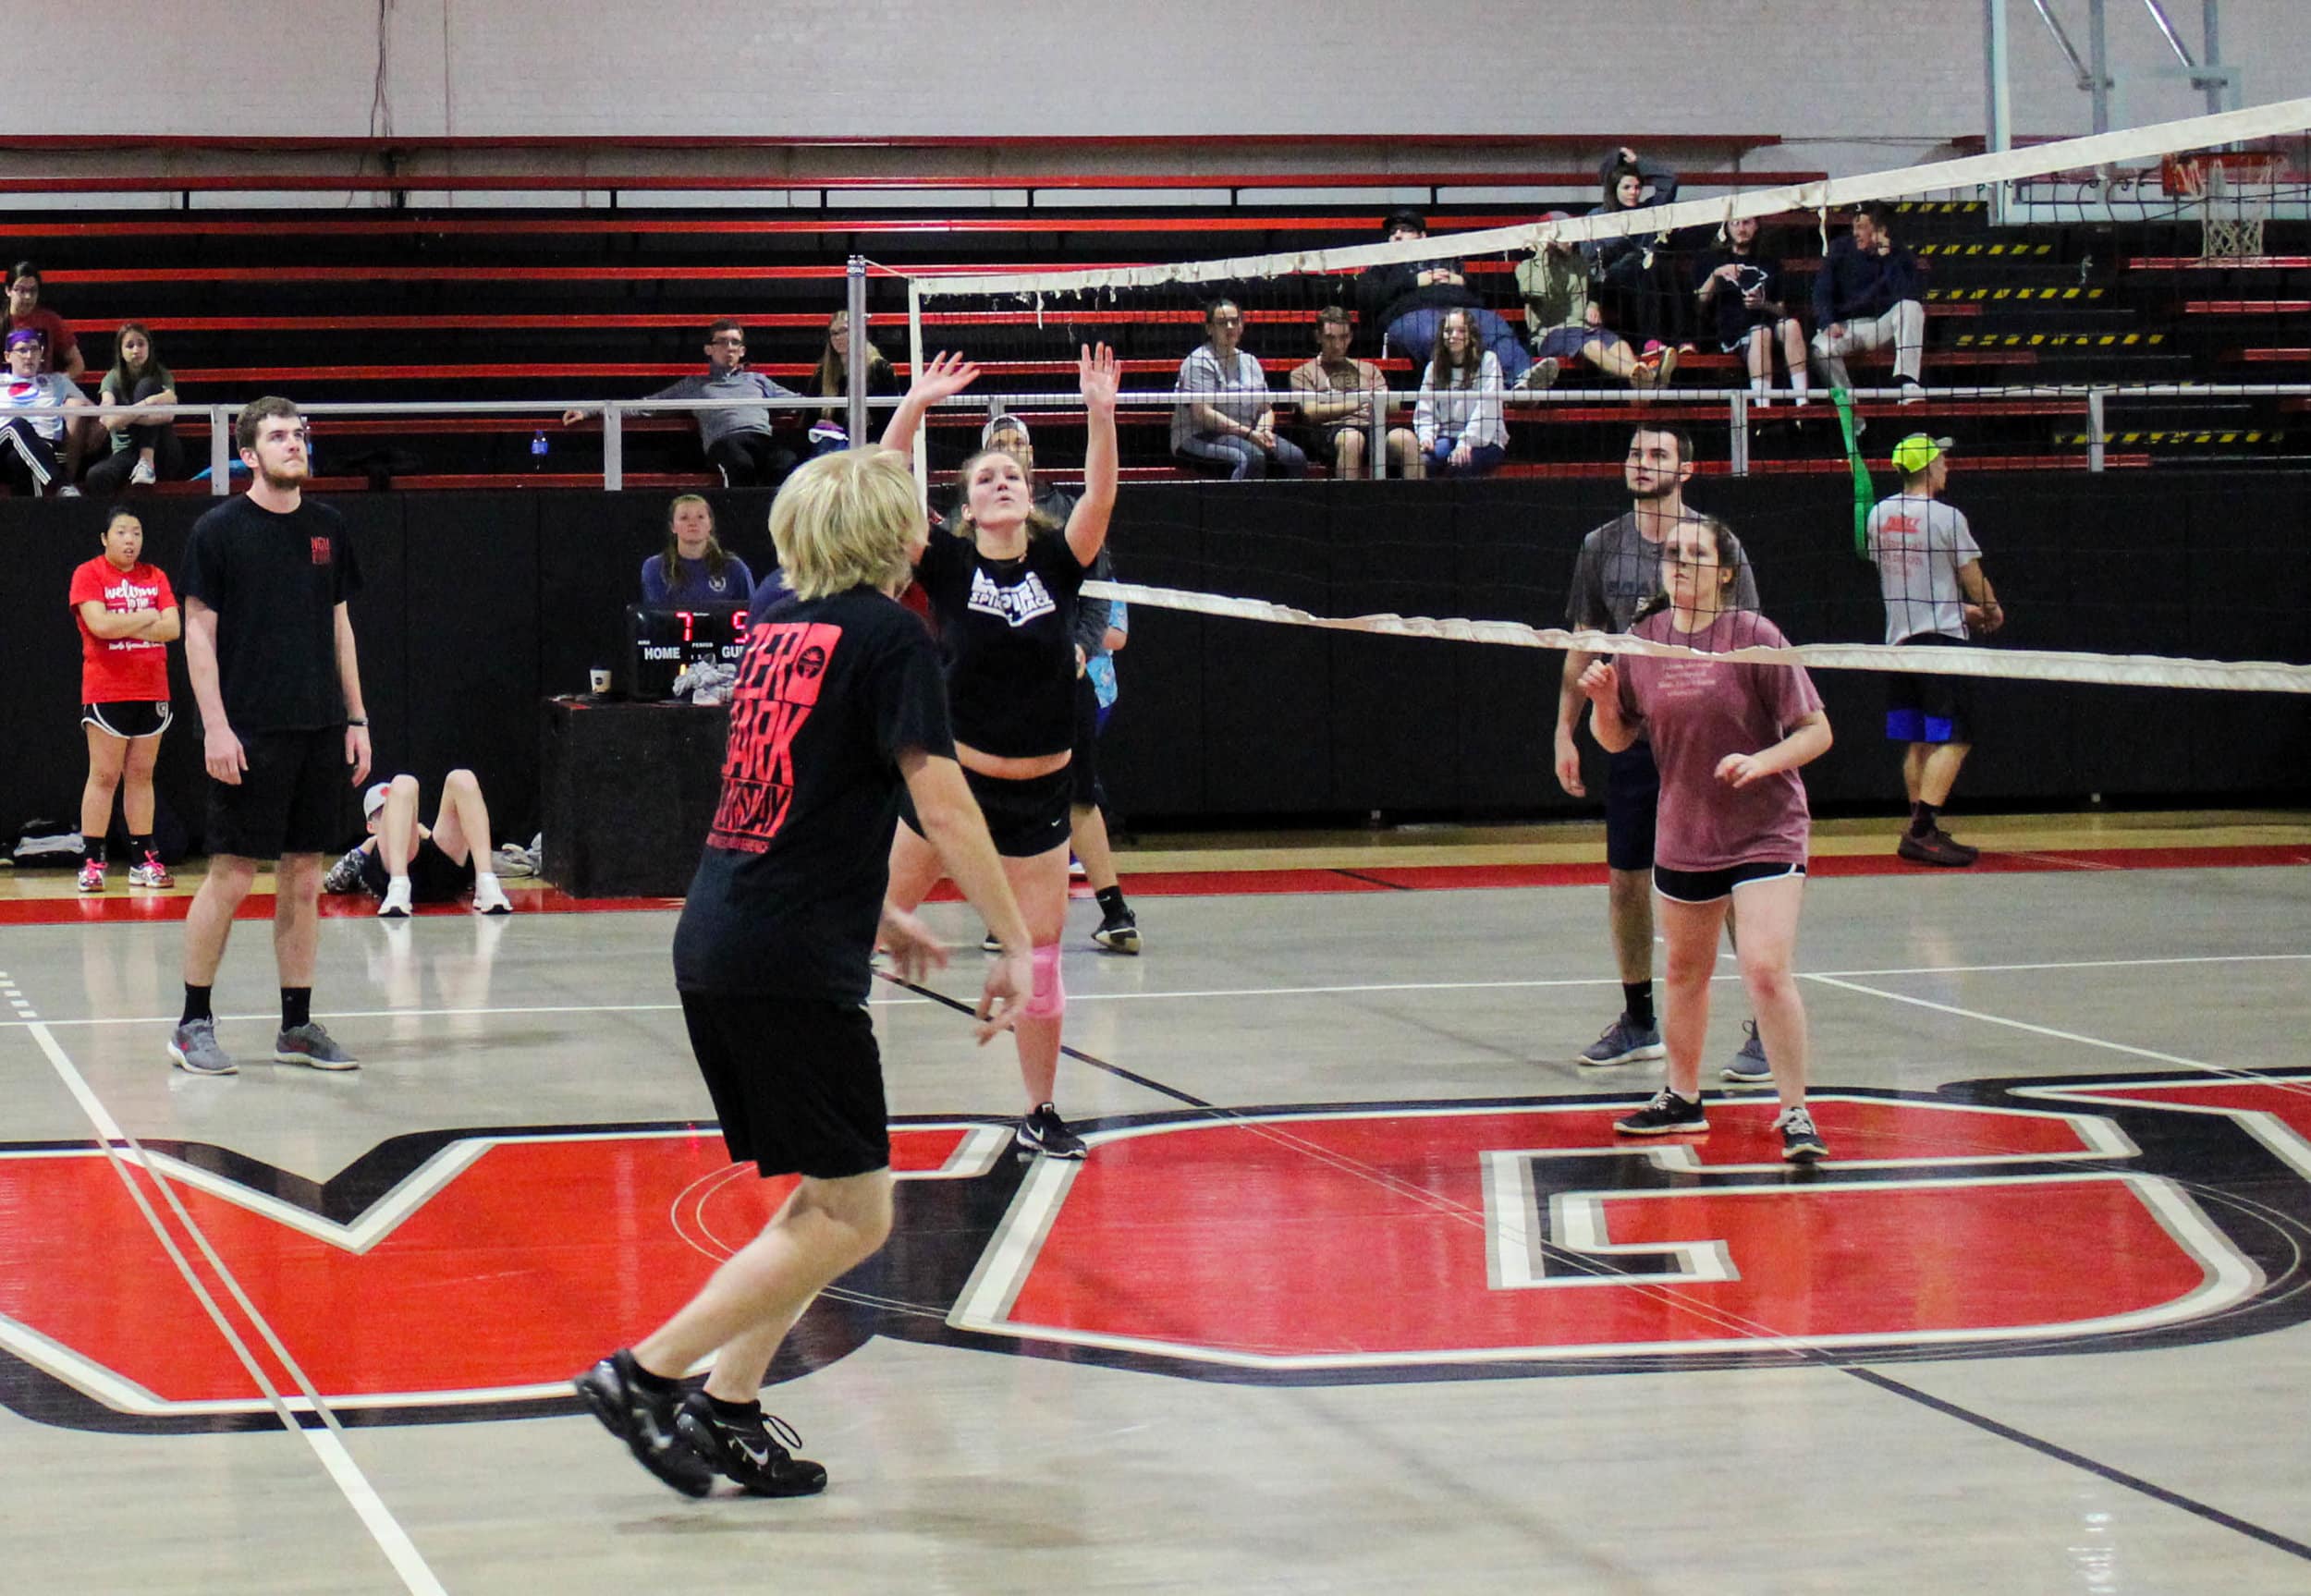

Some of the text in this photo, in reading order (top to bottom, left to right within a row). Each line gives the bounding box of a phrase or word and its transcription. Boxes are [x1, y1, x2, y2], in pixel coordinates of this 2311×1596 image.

[675, 611, 693, 641] 7
[644, 647, 681, 660] HOME
[733, 622, 842, 707] ZERO
